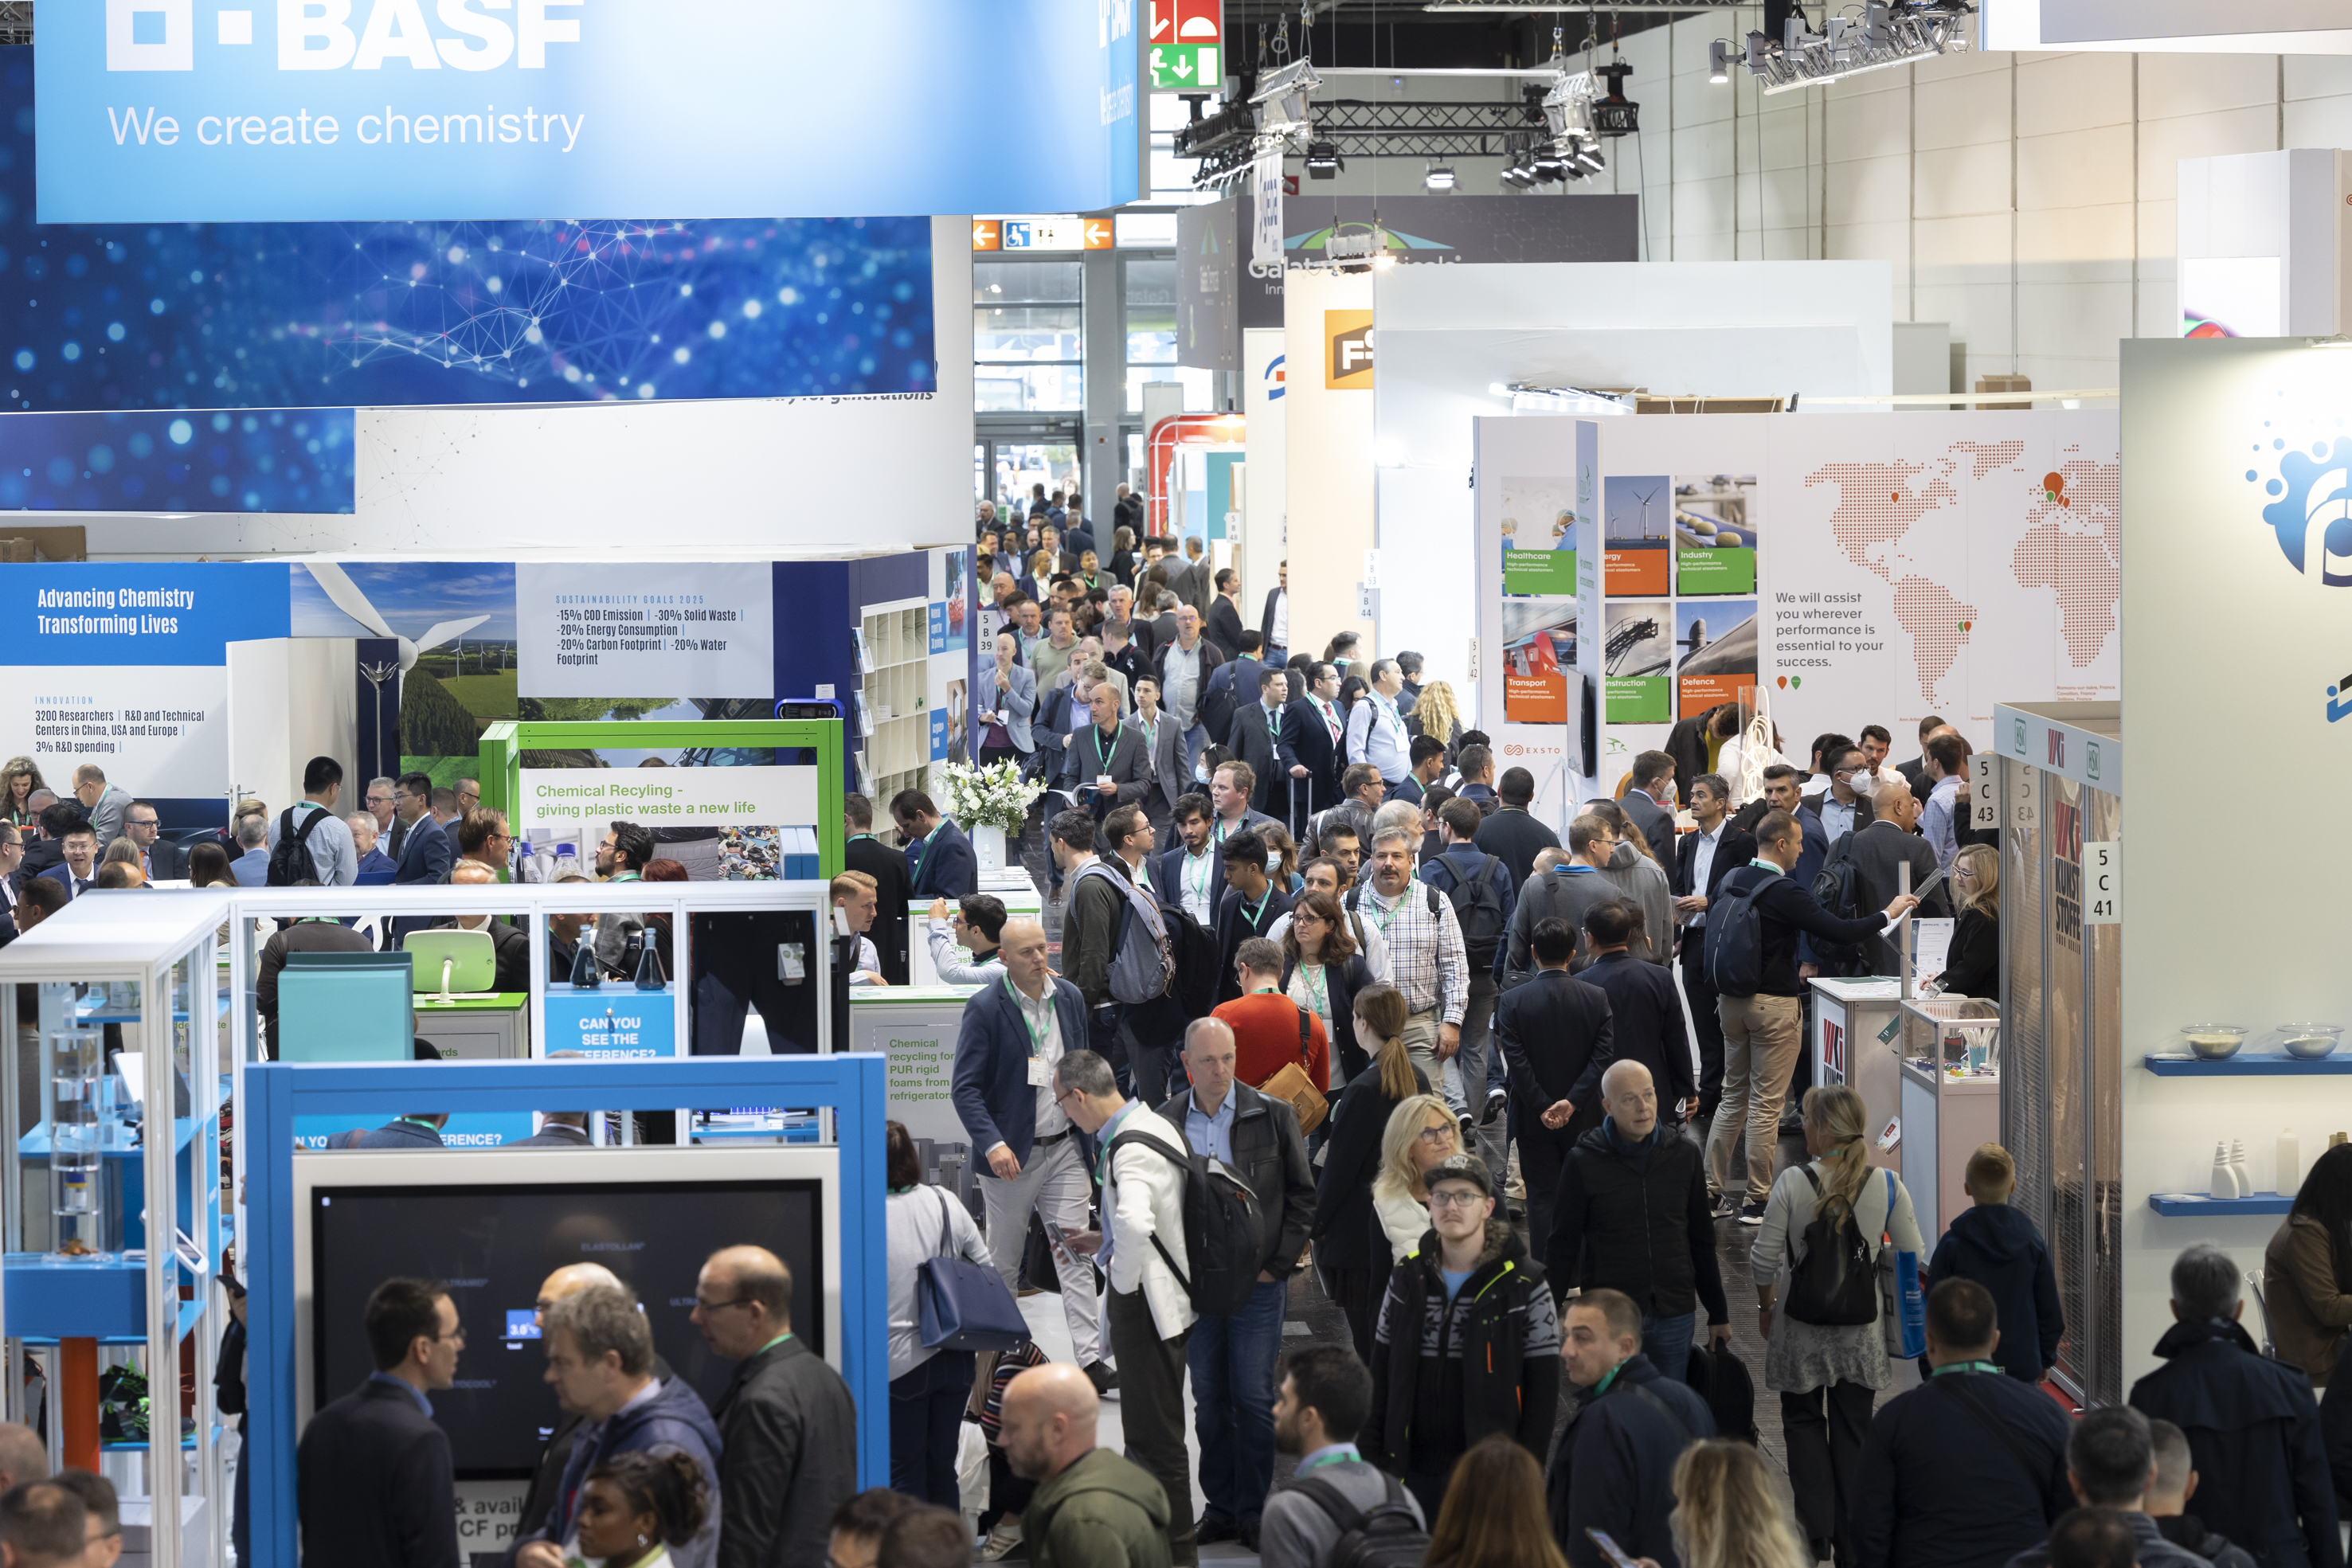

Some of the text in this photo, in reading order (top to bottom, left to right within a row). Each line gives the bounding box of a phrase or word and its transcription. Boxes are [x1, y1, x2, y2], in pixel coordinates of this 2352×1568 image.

[276, 0, 585, 71] BASF
[108, 104, 585, 153] We create chemistry
[37, 588, 194, 610] Advancing Chemistry
[556, 595, 704, 604] SUSTAINABILITY GOALS 2025
[1776, 592, 1862, 603] We will assist
[557, 609, 736, 621] -15% COD Emission -30% Solid Waste
[983, 615, 988, 624] 5
[1776, 608, 1862, 621] you wherever
[37, 614, 178, 635] Transforming Lives
[557, 624, 678, 637] -20% Energy Consumption
[1776, 624, 1875, 637] performance is
[983, 628, 989, 637] B
[557, 639, 727, 651] -20% Carbon Footprint -20% Water
[980, 641, 992, 651] 39
[1473, 641, 1477, 651] 5
[1776, 640, 1884, 653] essential to your
[558, 653, 598, 666] Footprint
[1472, 655, 1476, 664] C
[1470, 668, 1477, 678] 42
[1509, 678, 1547, 687] Transport
[35, 696, 93, 705] INNOVATION
[35, 710, 205, 721] 3200 Researchers R&D and Technical
[36, 725, 178, 737] Centers in China, USA and Europe
[2016, 725, 2025, 747] HSK
[36, 741, 115, 753] 3% R&D spending
[2088, 749, 2099, 772] HSK
[1981, 761, 1989, 776] 5
[536, 784, 605, 797] Chemical
[610, 784, 673, 799] Recyling
[1981, 784, 1990, 799] C
[536, 801, 756, 819] giving plastic waste a new life
[1977, 807, 1994, 822] 43
[2099, 850, 2107, 866] 5
[2056, 857, 2080, 902] KUNST
[2099, 875, 2109, 891] C
[2093, 900, 2112, 916] 41
[2056, 894, 2080, 941] STOFFE
[579, 1017, 641, 1030] CAN YOU
[581, 1033, 639, 1045] SEE THE
[890, 1038, 939, 1048] Chemical
[890, 1052, 955, 1062] recycling for
[890, 1065, 940, 1076] PUR rigid
[890, 1077, 950, 1087] foams from
